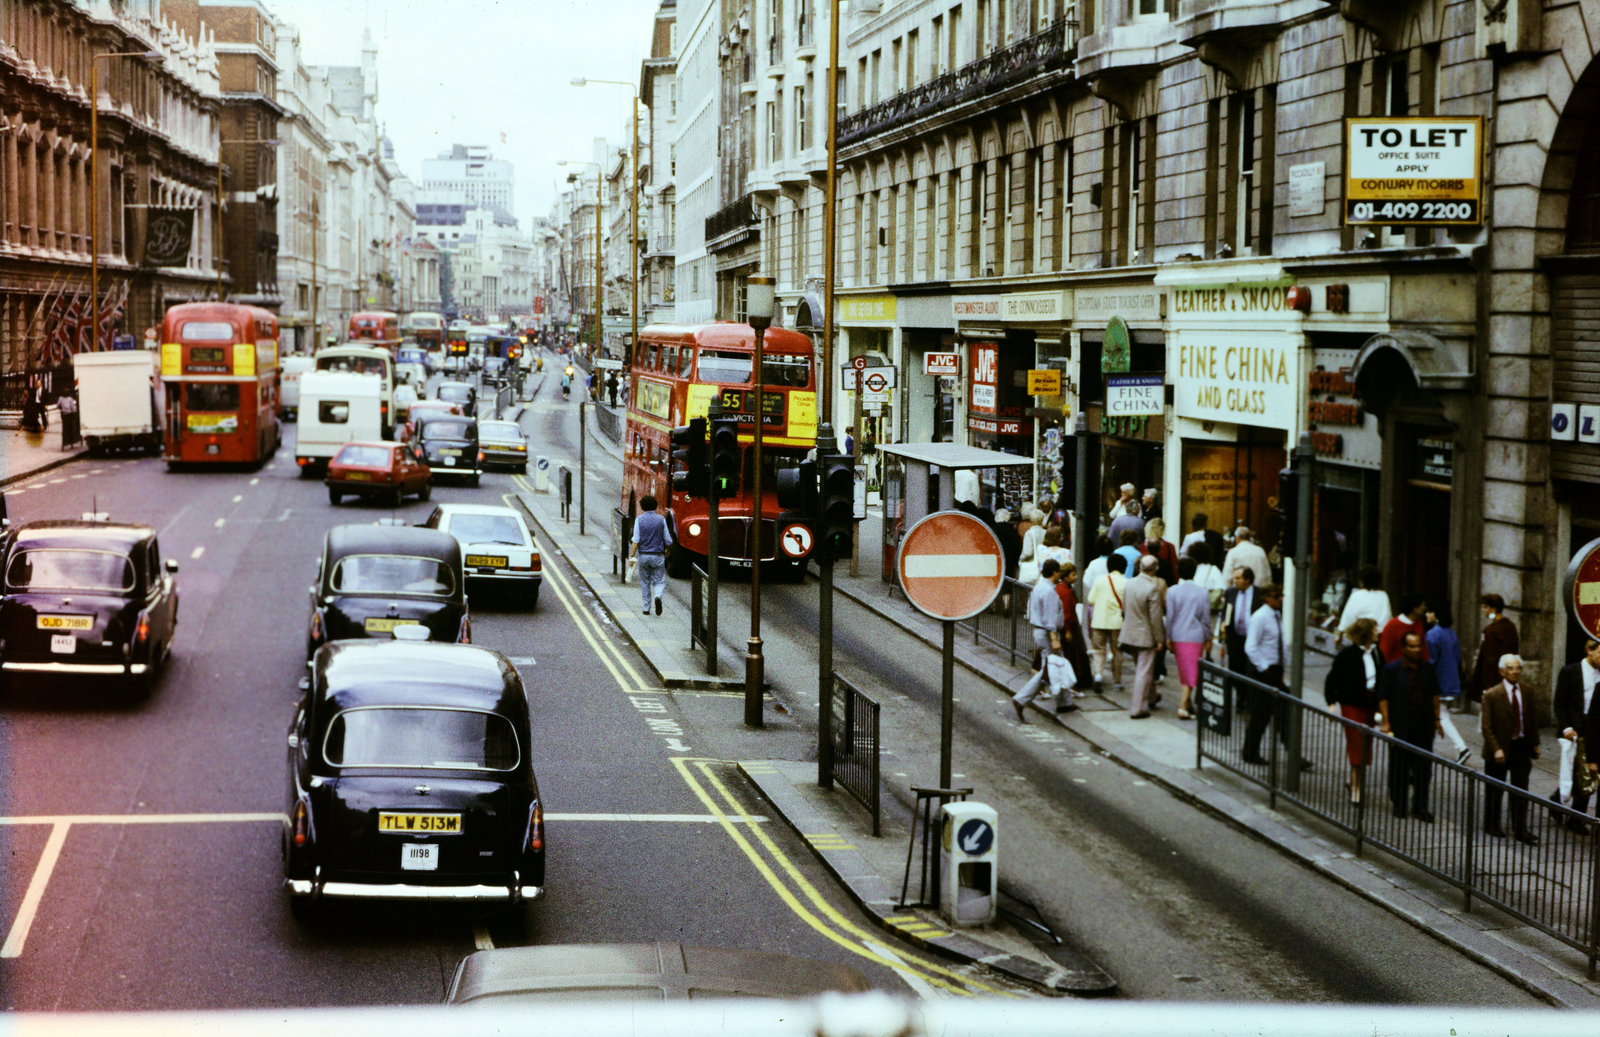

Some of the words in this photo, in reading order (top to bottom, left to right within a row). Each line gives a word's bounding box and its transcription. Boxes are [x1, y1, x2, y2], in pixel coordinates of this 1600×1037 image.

[1361, 128, 1403, 148] TO
[1410, 128, 1467, 147] LET
[1378, 151, 1410, 160] OFFICE
[1415, 151, 1441, 160] SUITE
[1396, 164, 1429, 173] APPLY
[1361, 179, 1414, 190] CONWAY
[1417, 179, 1464, 190] MORRIS
[1353, 202, 1418, 219] 01-409
[1421, 202, 1472, 219] 2200
[1174, 288, 1228, 313] LEATHER
[1231, 298, 1237, 311] &
[954, 301, 984, 314] WESTMINSTER
[985, 301, 999, 314] AUDIO
[1007, 300, 1018, 315] THE
[1019, 299, 1056, 315] CONNOISSEUR
[855, 358, 864, 369] G
[931, 355, 954, 366] JVC
[974, 348, 995, 383] JVC
[1179, 345, 1217, 379] FINE
[1224, 345, 1289, 385] CHINA
[1119, 387, 1152, 398] FINE
[723, 393, 740, 408] 55
[1197, 385, 1222, 409] AND
[1226, 388, 1266, 414] GLASS
[1113, 400, 1160, 411] CHINA
[732, 414, 771, 424] VICTOIA
[1001, 423, 1018, 433] JVC
[65, 618, 88, 628] 718R
[384, 816, 415, 830] TLW
[420, 816, 457, 831] 513M
[410, 848, 430, 858] 11198
